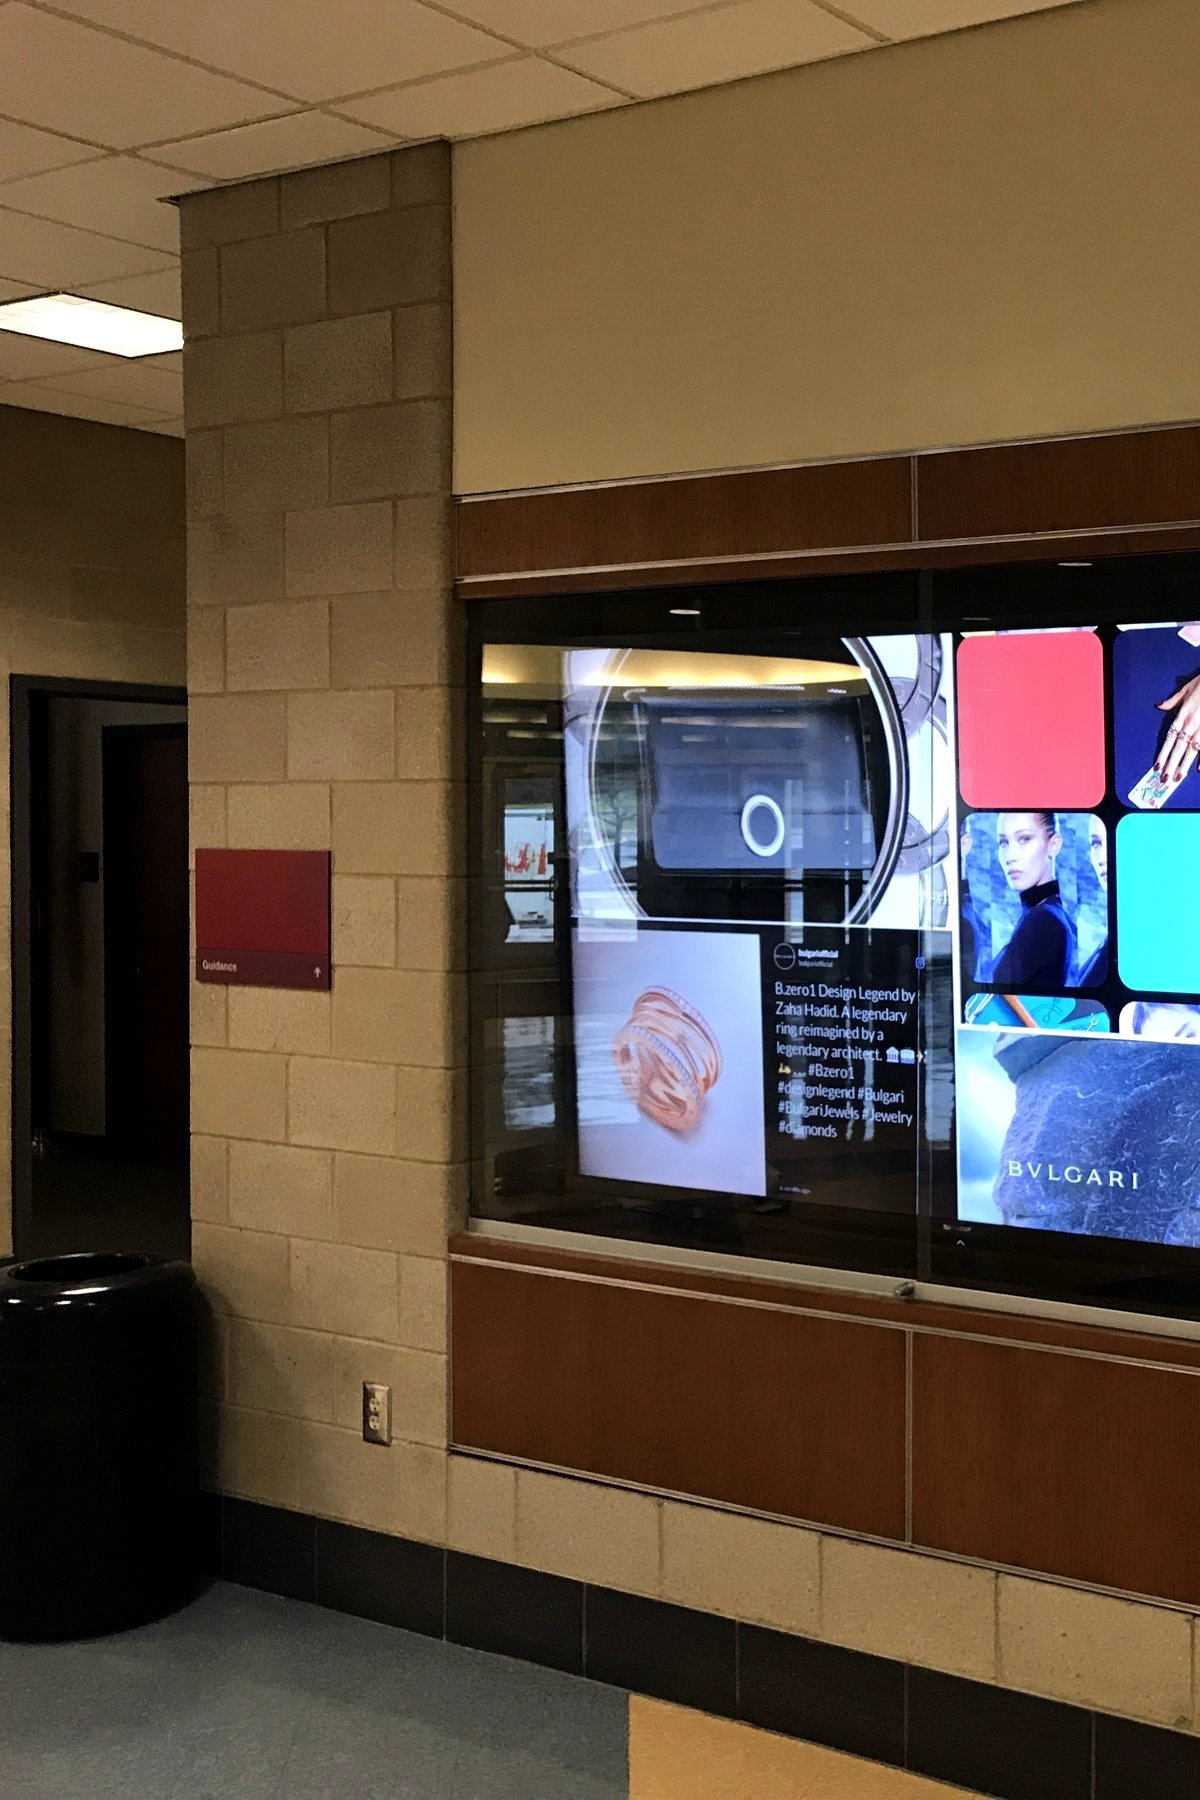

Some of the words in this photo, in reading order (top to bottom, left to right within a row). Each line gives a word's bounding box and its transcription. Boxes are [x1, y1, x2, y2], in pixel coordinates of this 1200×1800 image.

[202, 960, 237, 972] Guidance
[775, 981, 816, 998] B.zero1
[818, 984, 857, 1001] Design
[859, 986, 899, 1003] Legend
[901, 988, 916, 1004] by
[775, 1001, 802, 1016] Zaha
[804, 1003, 839, 1018] Hadid.
[841, 1005, 851, 1019] A
[852, 1006, 907, 1024] legendary
[776, 1021, 797, 1038] ring
[798, 1023, 859, 1040] reimagined
[861, 1027, 875, 1043] by
[877, 1030, 884, 1041] a
[776, 1041, 829, 1059] legendary
[831, 1046, 883, 1061] architect.
[808, 1063, 855, 1080] #Bzero1
[778, 1081, 855, 1100] #designlegend
[857, 1086, 905, 1105] #Bulgari
[778, 1100, 860, 1120] #BulgariJewels
[862, 1107, 913, 1127] #Jewelry
[778, 1120, 838, 1138] #diamonds
[1008, 1160, 1138, 1190] BVLGARI
